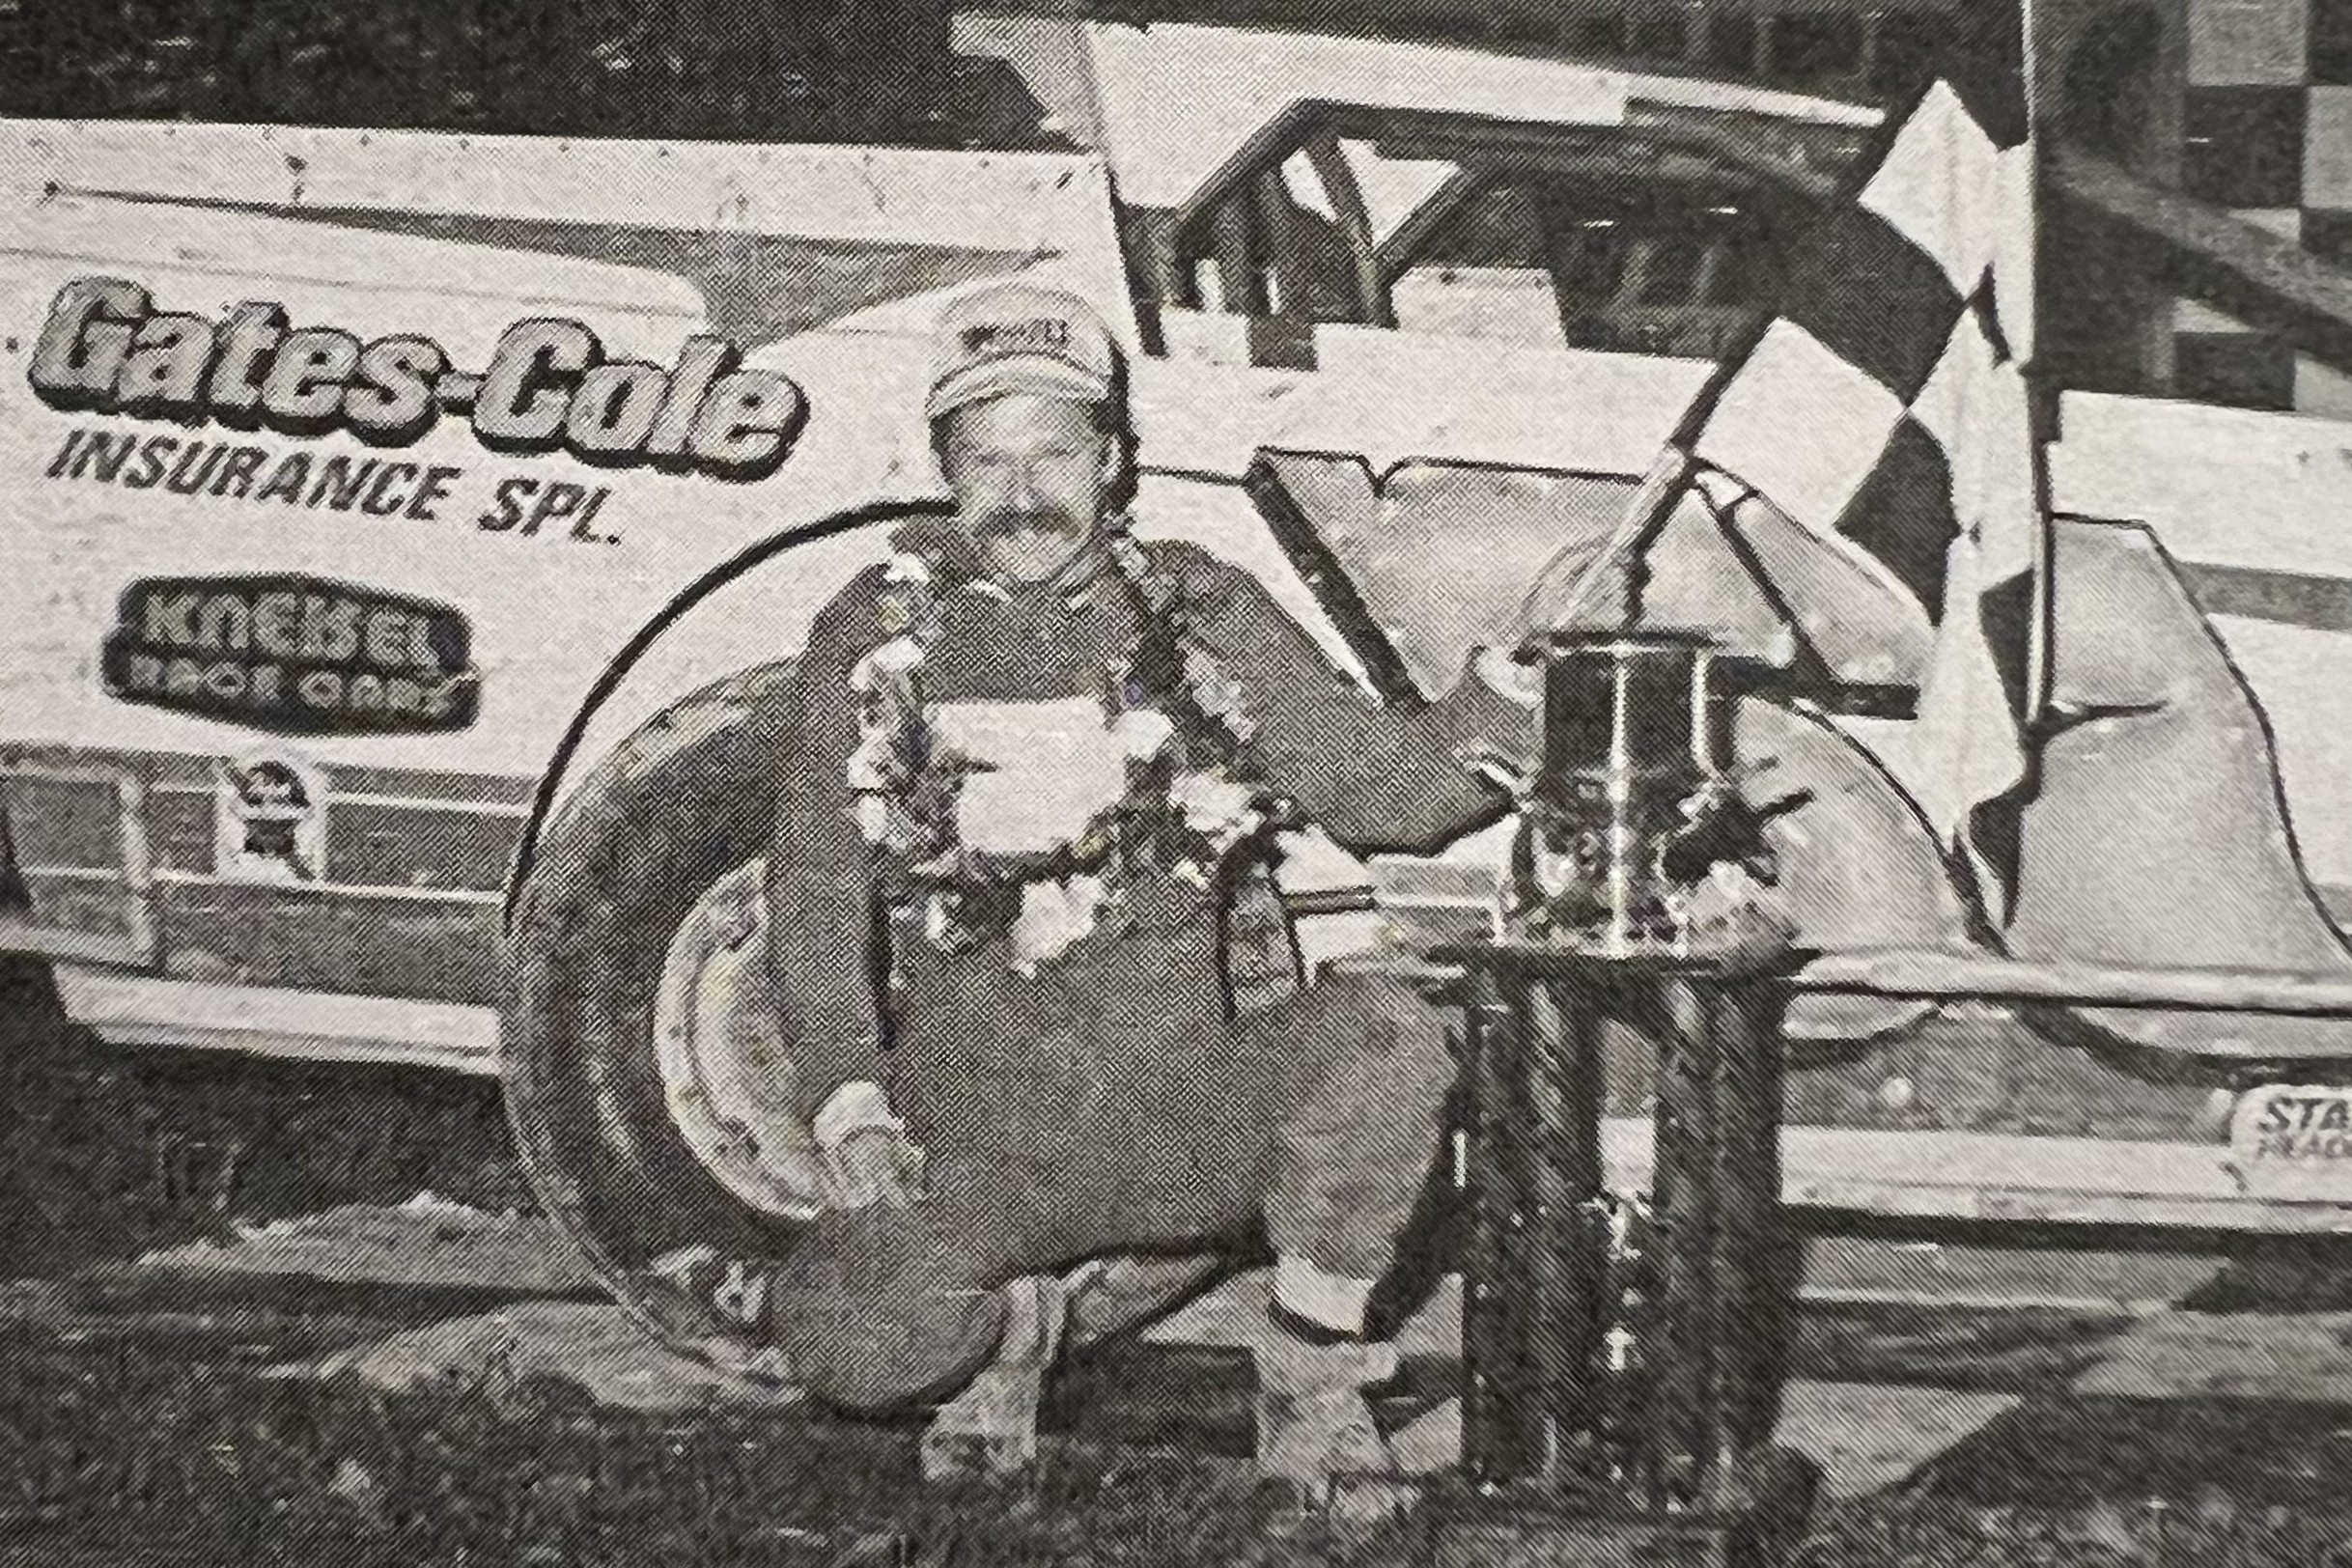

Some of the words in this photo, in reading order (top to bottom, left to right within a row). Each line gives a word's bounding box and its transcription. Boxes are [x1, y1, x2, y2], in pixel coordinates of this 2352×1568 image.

[28, 275, 811, 484] Gates-Cole
[45, 429, 462, 521] INSURANCE
[477, 475, 622, 547] SPL.
